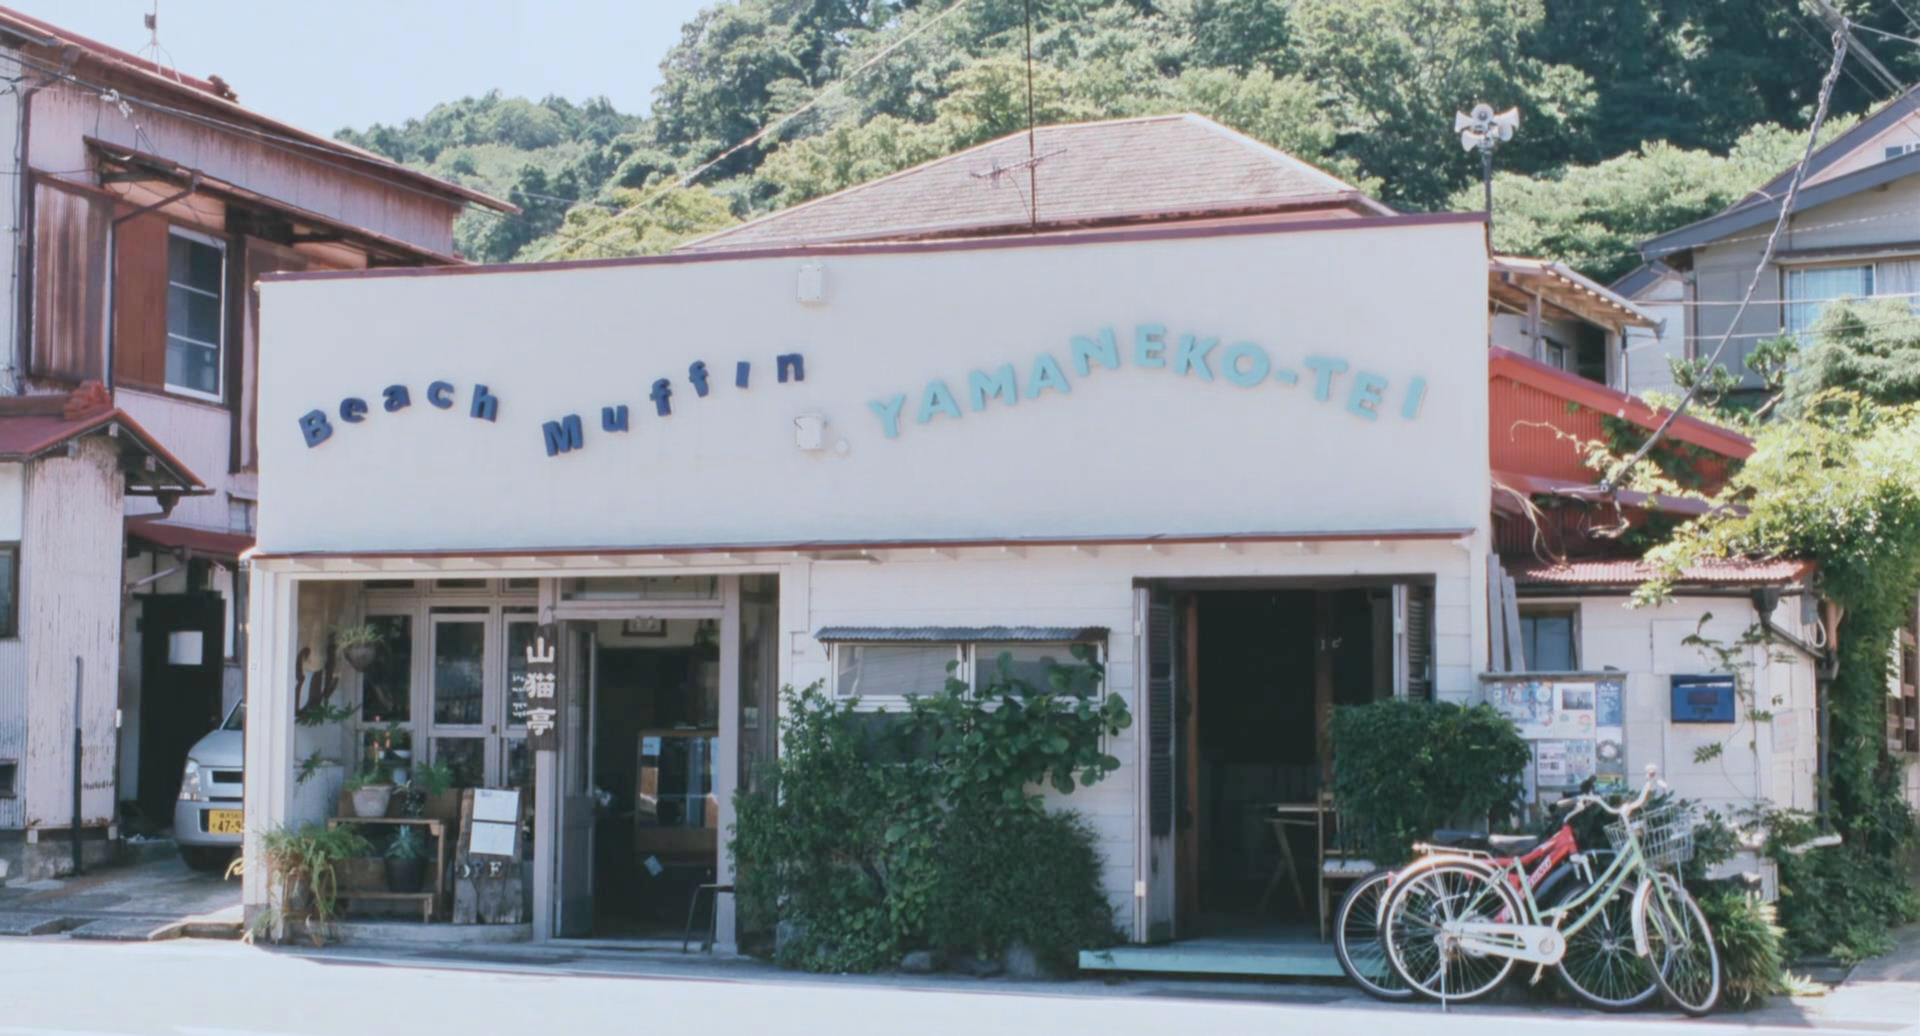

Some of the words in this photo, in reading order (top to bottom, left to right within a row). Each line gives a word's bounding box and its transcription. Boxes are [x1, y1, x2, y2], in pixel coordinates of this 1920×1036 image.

[299, 380, 498, 449] Beach
[541, 353, 805, 457] Muffin
[866, 323, 1427, 440] YAMANEKO-TEI
[525, 636, 557, 737] 山猫亭
